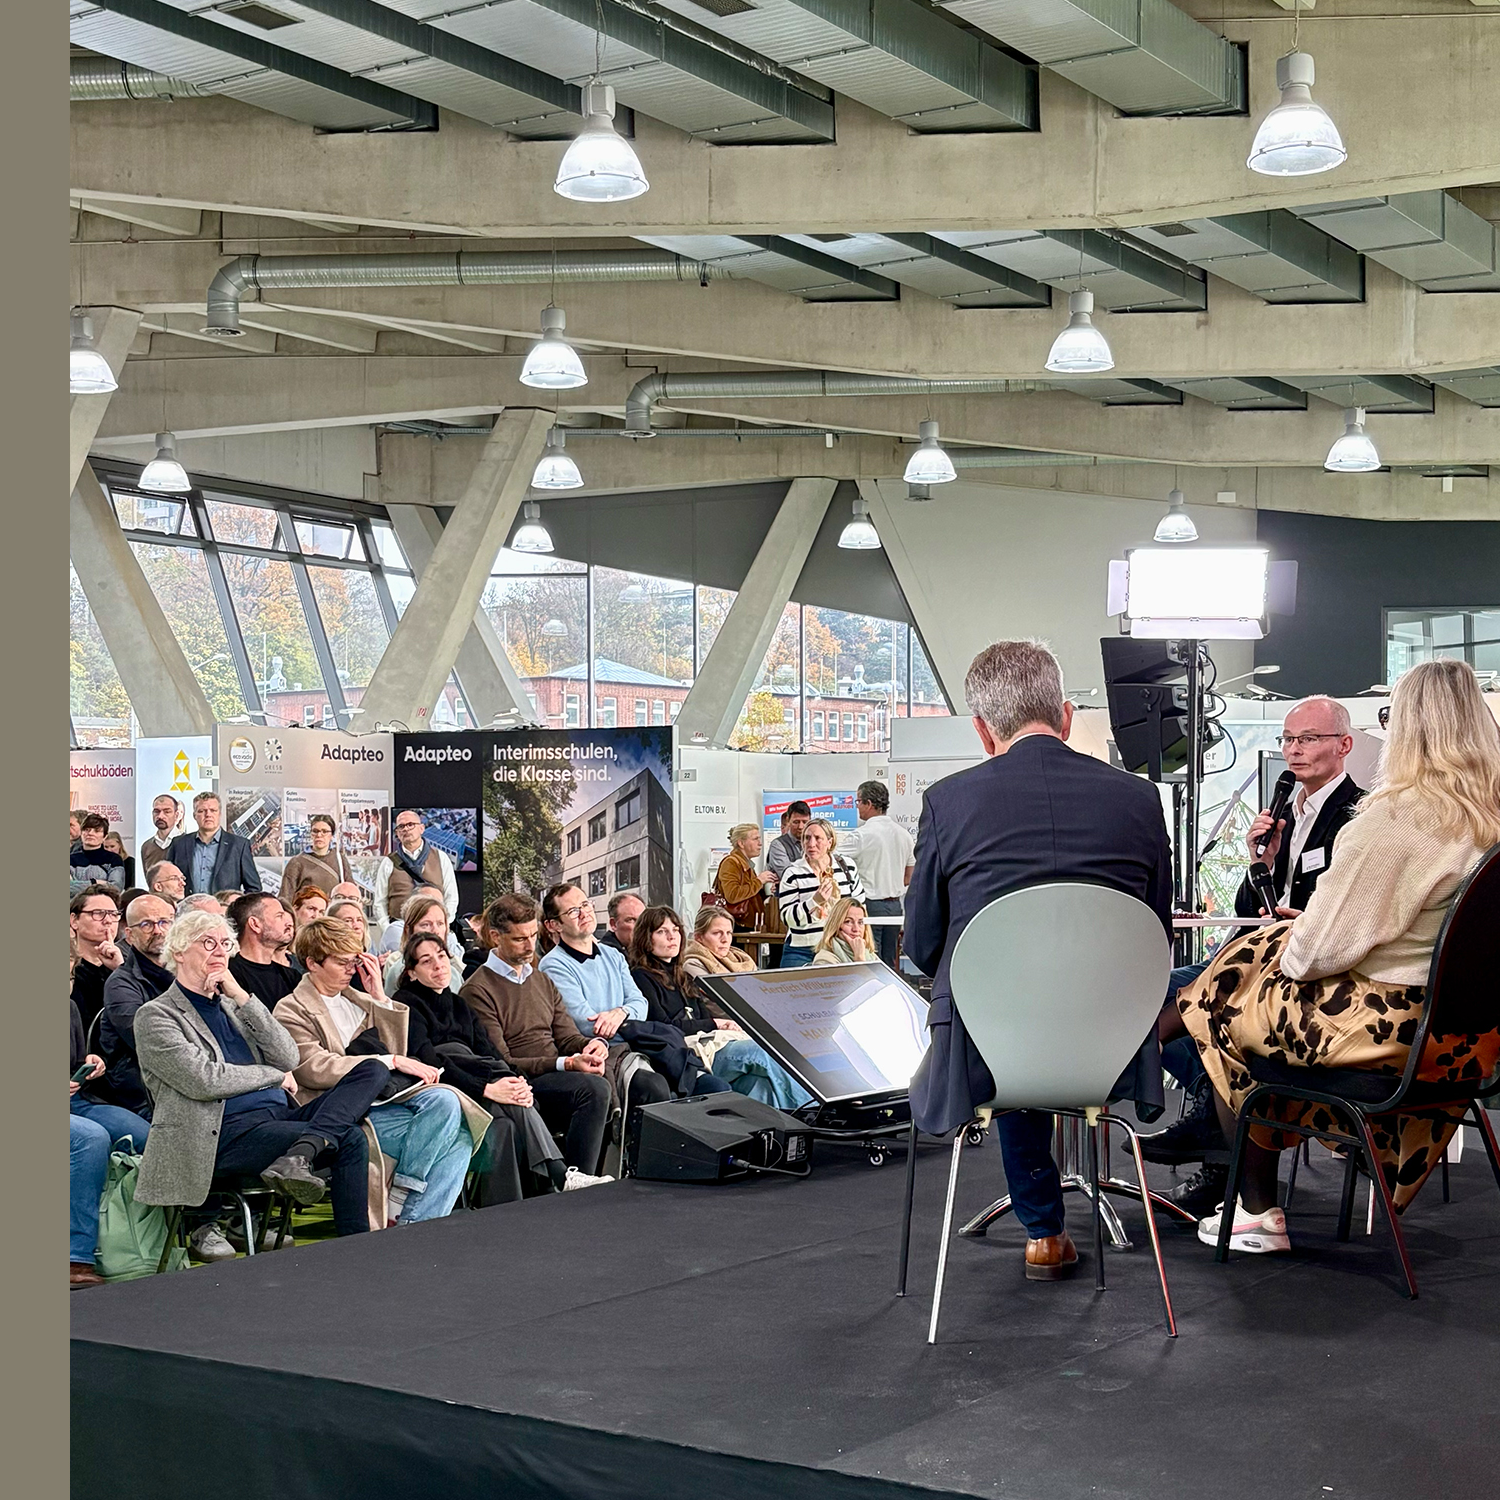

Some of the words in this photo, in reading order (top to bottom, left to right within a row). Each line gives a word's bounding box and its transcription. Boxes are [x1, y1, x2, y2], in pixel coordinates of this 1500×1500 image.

[321, 744, 384, 764] Adapteo
[404, 745, 473, 766] Adapteo
[493, 743, 618, 763] Interimsschulen,
[70, 764, 133, 778] tschukböden
[493, 766, 517, 782] die
[521, 765, 572, 782] Klasse
[575, 765, 612, 782] sind.
[694, 805, 714, 814] ELTON
[715, 806, 727, 815] B.V.
